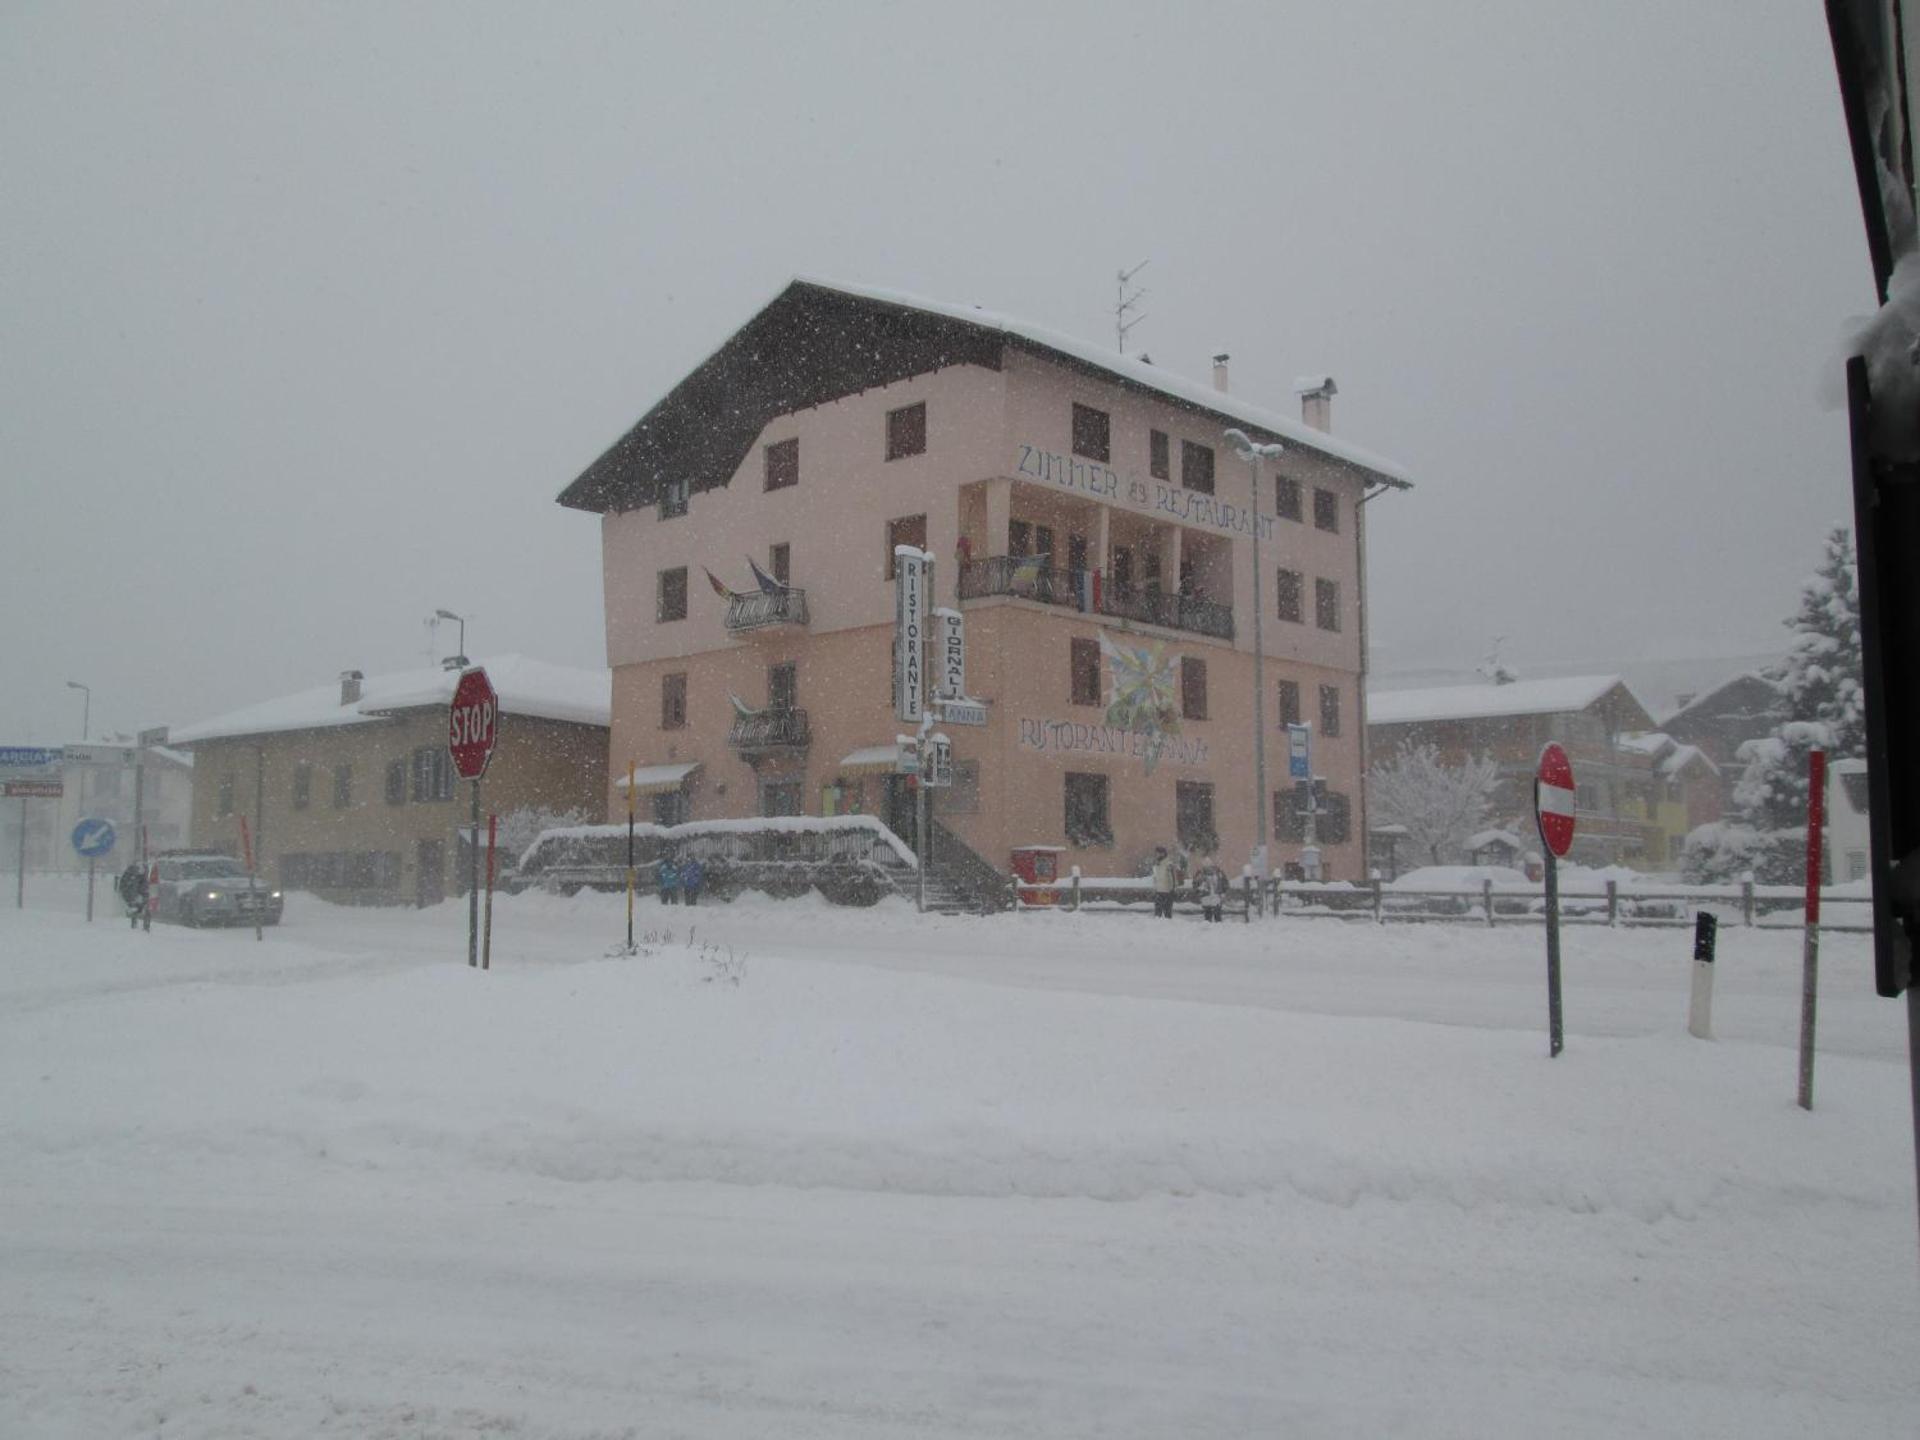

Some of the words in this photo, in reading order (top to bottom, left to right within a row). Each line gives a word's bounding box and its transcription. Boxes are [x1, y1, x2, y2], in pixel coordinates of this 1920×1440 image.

[1019, 445, 1118, 499] ZIMMER
[1156, 485, 1275, 540] RESTAURANT
[908, 561, 919, 715] RISTORANTE
[946, 615, 962, 696] GIORNALI
[451, 700, 492, 747] STOP
[947, 706, 984, 722] ANNA
